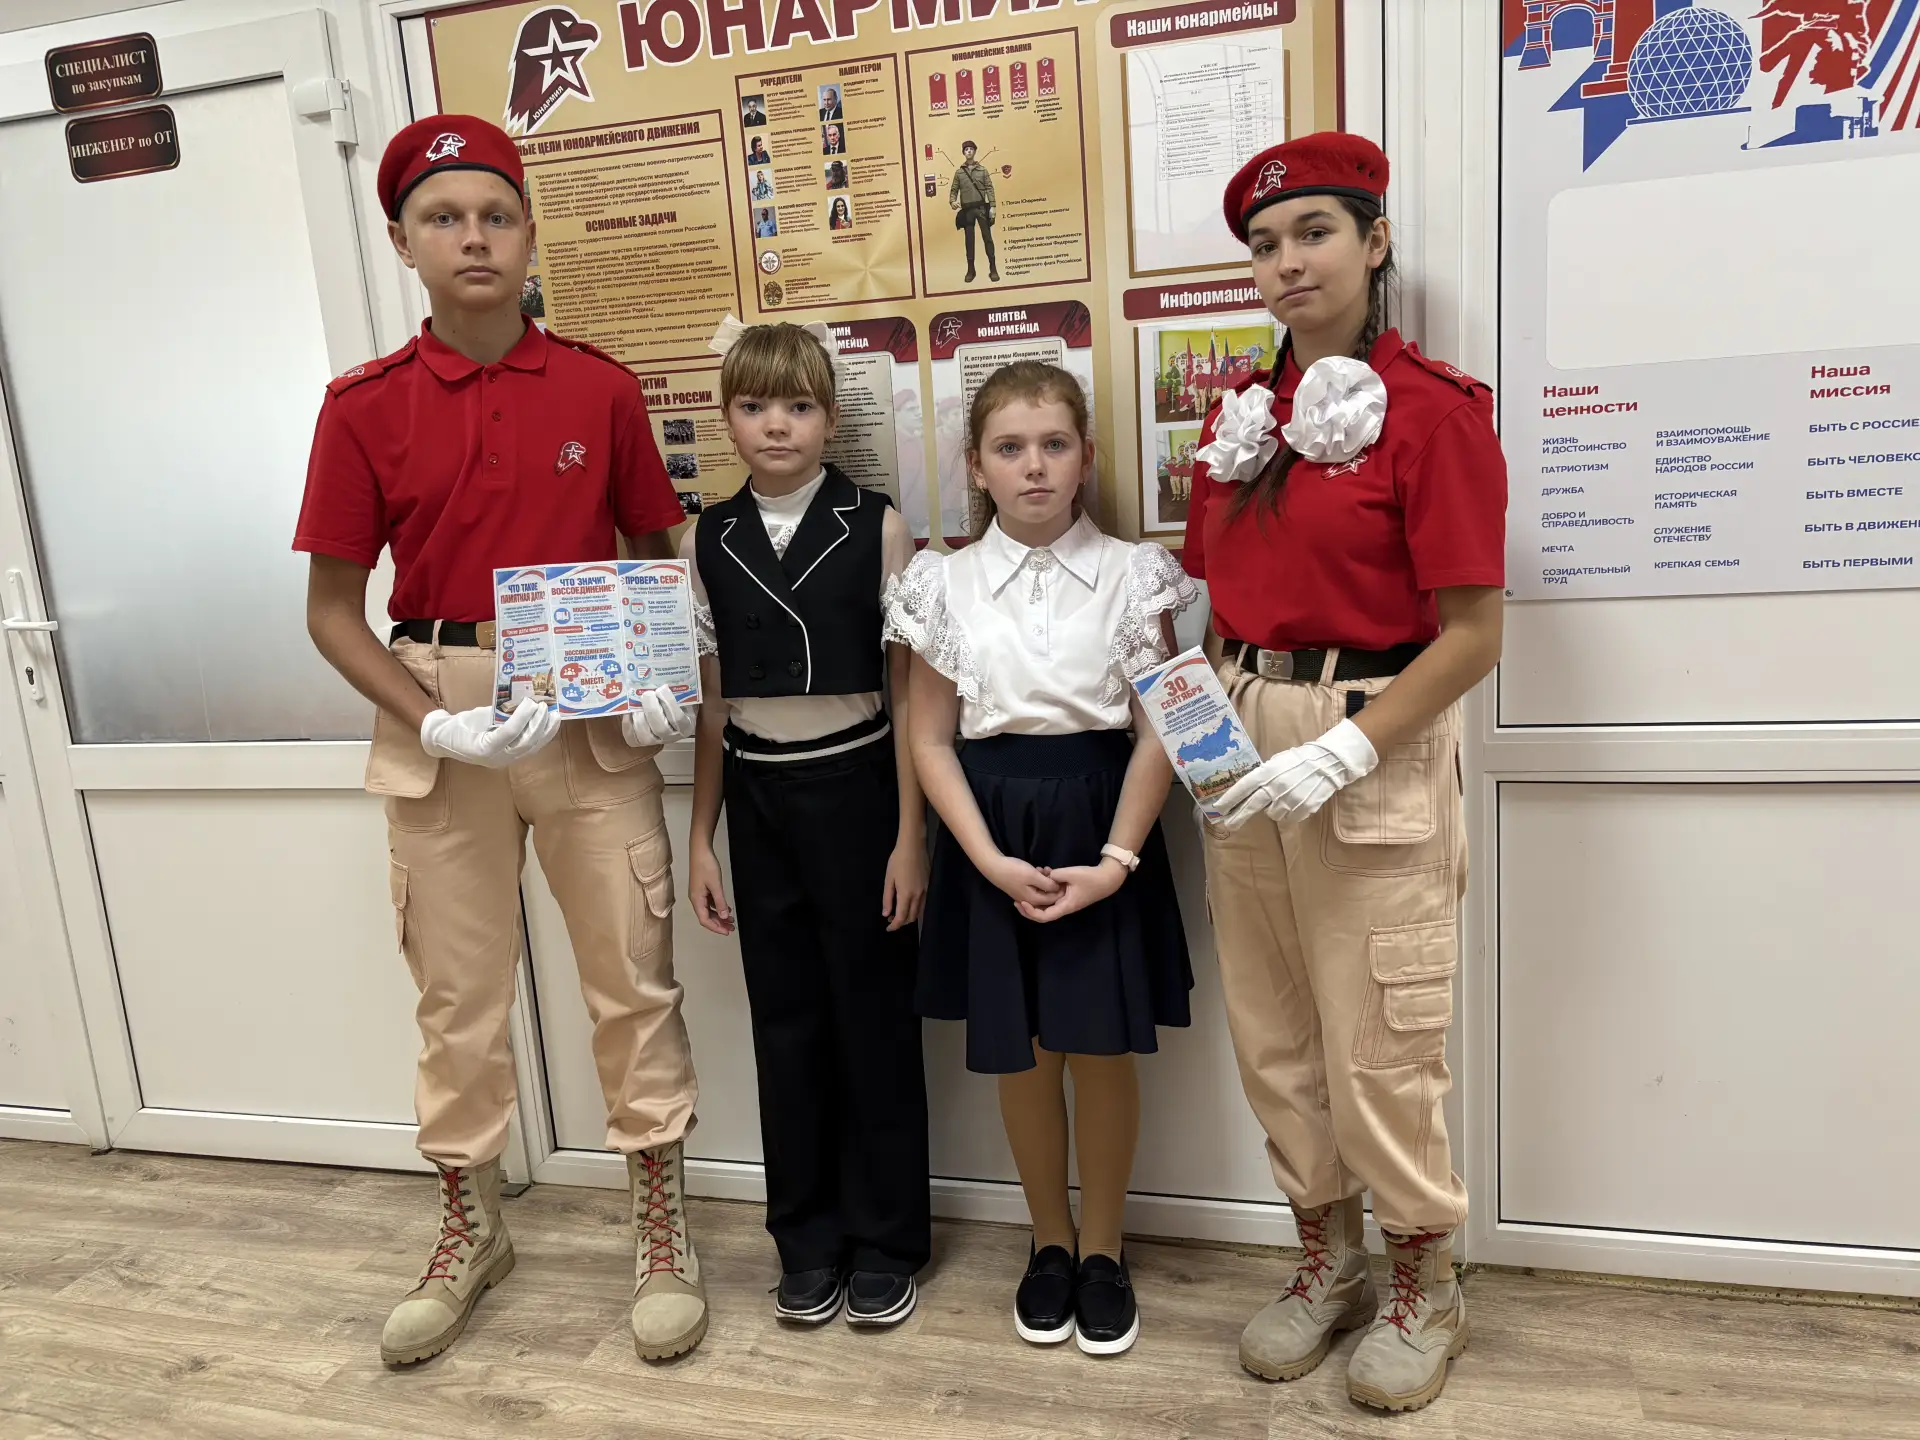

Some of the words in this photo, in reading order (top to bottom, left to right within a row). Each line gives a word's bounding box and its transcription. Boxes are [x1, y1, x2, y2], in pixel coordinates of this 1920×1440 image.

[1127, 16, 1172, 37] Наши
[1174, 1, 1278, 30] юнармейцы
[618, 0, 1088, 71] ЮНАР
[951, 46, 1004, 61] ЮНОАРМЕЙСКИЕ
[1005, 43, 1032, 54] ЗВАНИЯ
[55, 50, 147, 78] СПЕЦИАЛИСТ
[838, 66, 860, 77] НАШИ
[861, 63, 882, 74] ГЕРОИ
[71, 82, 86, 94] по
[88, 73, 142, 92] закупкам
[760, 74, 802, 88] УЧРЕДИТЕЛИ
[532, 85, 564, 120] ЮНАРМИЯ
[71, 136, 135, 159] ИНЖЕНЕР
[138, 137, 152, 148] по
[154, 130, 172, 145] ОТ
[538, 140, 561, 155] ЦЕЛИ
[562, 129, 645, 151] ЮНОАРМЕЙСКОГО
[646, 122, 700, 142] ДВИЖЕНИЯ
[585, 215, 638, 233] ОСНОВНЫЕ
[638, 210, 677, 228] ЗАДАЧИ
[1160, 287, 1262, 310] Информация
[988, 311, 1027, 324] КЛЯТВА
[977, 323, 1040, 337] ЮНАРМЕЙЦА
[1811, 365, 1871, 379] Наша
[1543, 384, 1599, 398] Наши
[1810, 384, 1891, 399] миссия
[663, 393, 670, 406] В
[672, 391, 713, 405] РОССИИ
[1543, 402, 1638, 418] ценности
[1809, 423, 1847, 433] БЫТЬ
[1850, 422, 1860, 431] С
[1862, 418, 1920, 430] РОССИЕ
[1656, 426, 1751, 439] ВЗАИМОПОМОЩЬ
[1542, 436, 1579, 446] ЖИЗНЬ
[1656, 439, 1664, 447] И
[1665, 433, 1771, 447] ВЗАИМОУВАЖЕНИЕ
[1551, 442, 1627, 454] ДОСТОИНСТВО
[1655, 455, 1712, 466] ЕДИНСТВО
[1807, 456, 1845, 466] БЫТЬ
[1848, 452, 1920, 465] ЧЕЛОВЕКО
[1541, 463, 1609, 474] ПАТРИОТИЗМ
[1655, 464, 1707, 474] НАРОДОВ
[1710, 461, 1754, 471] РОССИИ
[1541, 486, 1585, 496] ДРУЖБА
[1654, 490, 1737, 501] ИСТОРИЧЕСКАЯ
[1806, 490, 1844, 500] БЫТЬ
[1846, 487, 1903, 498] ВМЕСТЕ
[1654, 500, 1697, 510] ПАМЯТЬ
[1541, 511, 1576, 521] ДОБРО
[1578, 511, 1586, 519] И
[1541, 517, 1635, 529] СПРАВЕДЛИВОСТЬ
[1804, 523, 1842, 533] БЫТЬ
[1845, 522, 1854, 531] В
[1856, 519, 1920, 531] ДВИЖЕН
[1653, 525, 1712, 535] СЛУЖЕНИЕ
[1653, 534, 1712, 544] ОТЕЧЕСТВУ
[1541, 545, 1575, 554] МЕЧТА
[1654, 560, 1701, 569] КРЕПКАЯ
[1704, 559, 1740, 568] СЕМЬЯ
[1803, 559, 1840, 569] БЫТЬ
[1843, 556, 1913, 568] ПЕРВЫМИ
[1542, 565, 1631, 577] СОЗИДАТЕЛЬНЫЙ
[560, 578, 575, 587] ЧТО
[577, 576, 606, 586] ЗНАЧИТ
[625, 575, 659, 585] ПРОВЕРЬ
[660, 575, 679, 584] СЕБЯ
[1542, 576, 1568, 585] ТРУД
[508, 584, 519, 594] ЧТО
[551, 584, 616, 597] ВОССОЕДИНЕНИЕ?
[565, 648, 611, 657] ВОССОЕДИНЕНИЕ
[580, 677, 604, 686] ВМЕСТЕ
[1163, 675, 1189, 698] 30
[1160, 684, 1204, 710] СЕНТЯБРЯ
